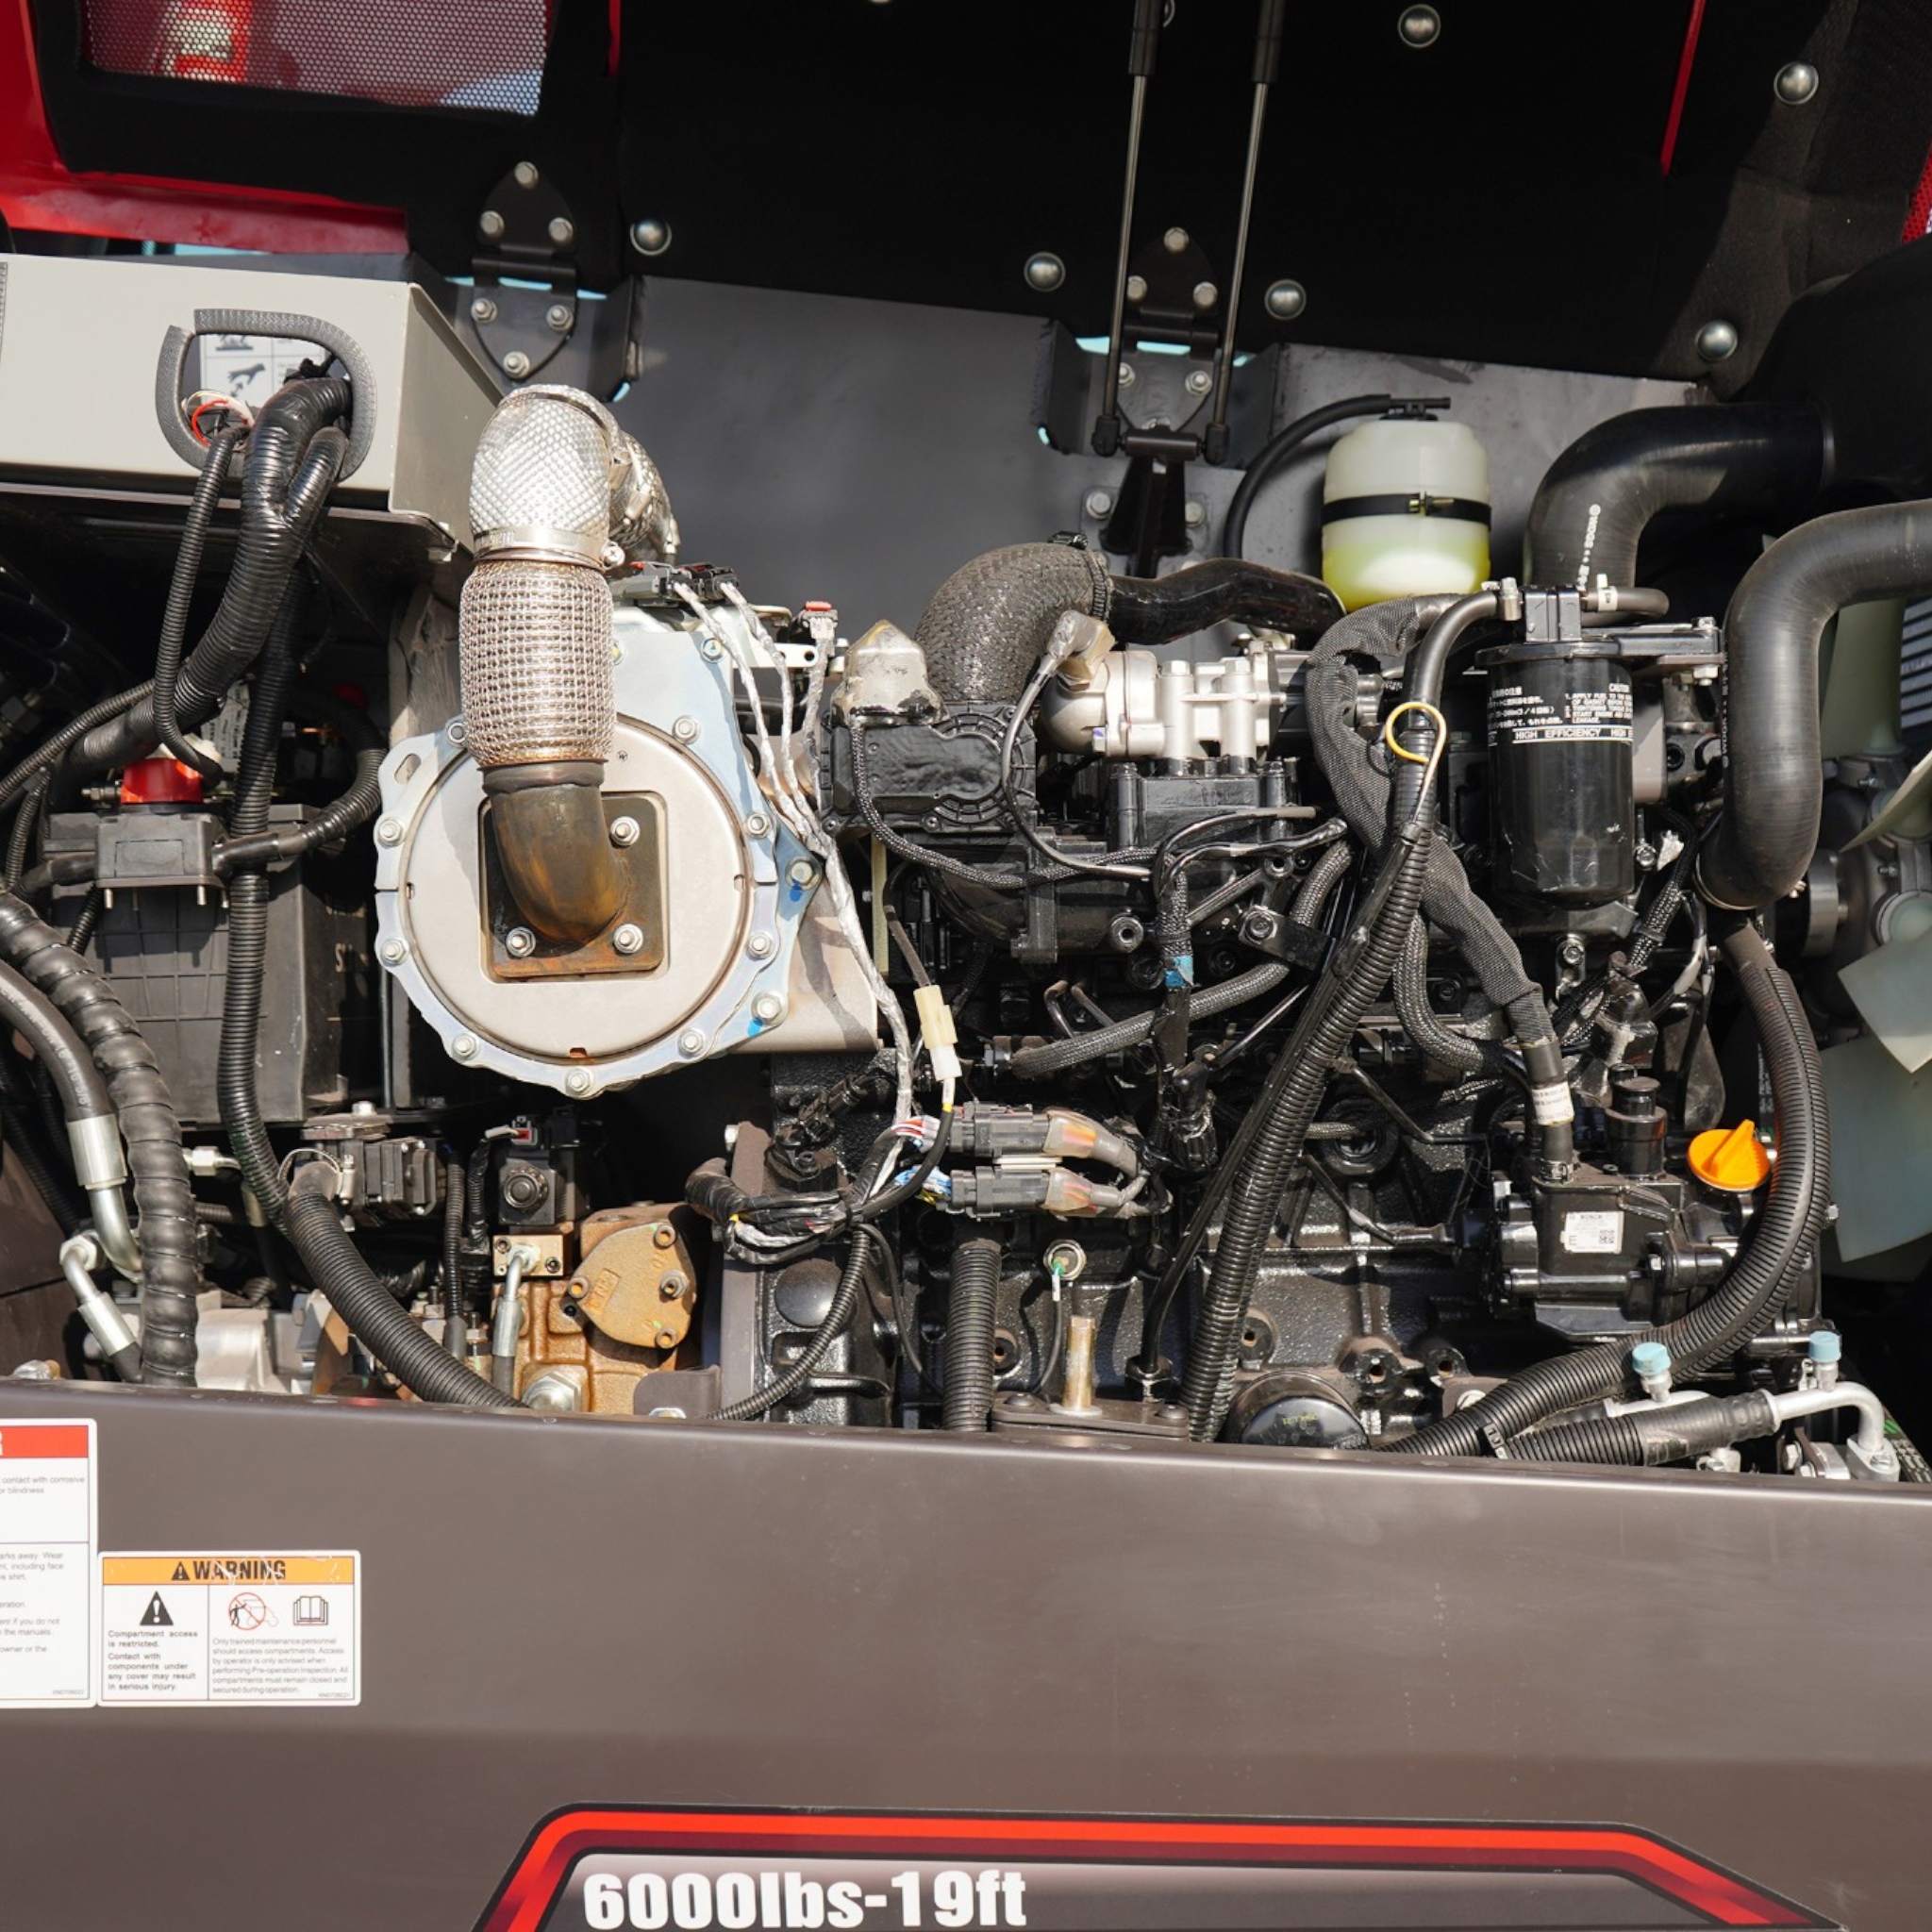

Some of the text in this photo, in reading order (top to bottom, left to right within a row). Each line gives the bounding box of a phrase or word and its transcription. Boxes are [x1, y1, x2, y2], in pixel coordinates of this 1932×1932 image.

[1516, 730, 1538, 740] HIGH
[1545, 728, 1601, 739] EFFICIENCY
[11, 1562, 45, 1571] including
[193, 1560, 286, 1580] WARNING
[302, 1638, 337, 1646] personnel
[213, 1667, 250, 1675] performing
[152, 1683, 175, 1691] injury.
[582, 1868, 1026, 1929] 6000lbs-19ft
